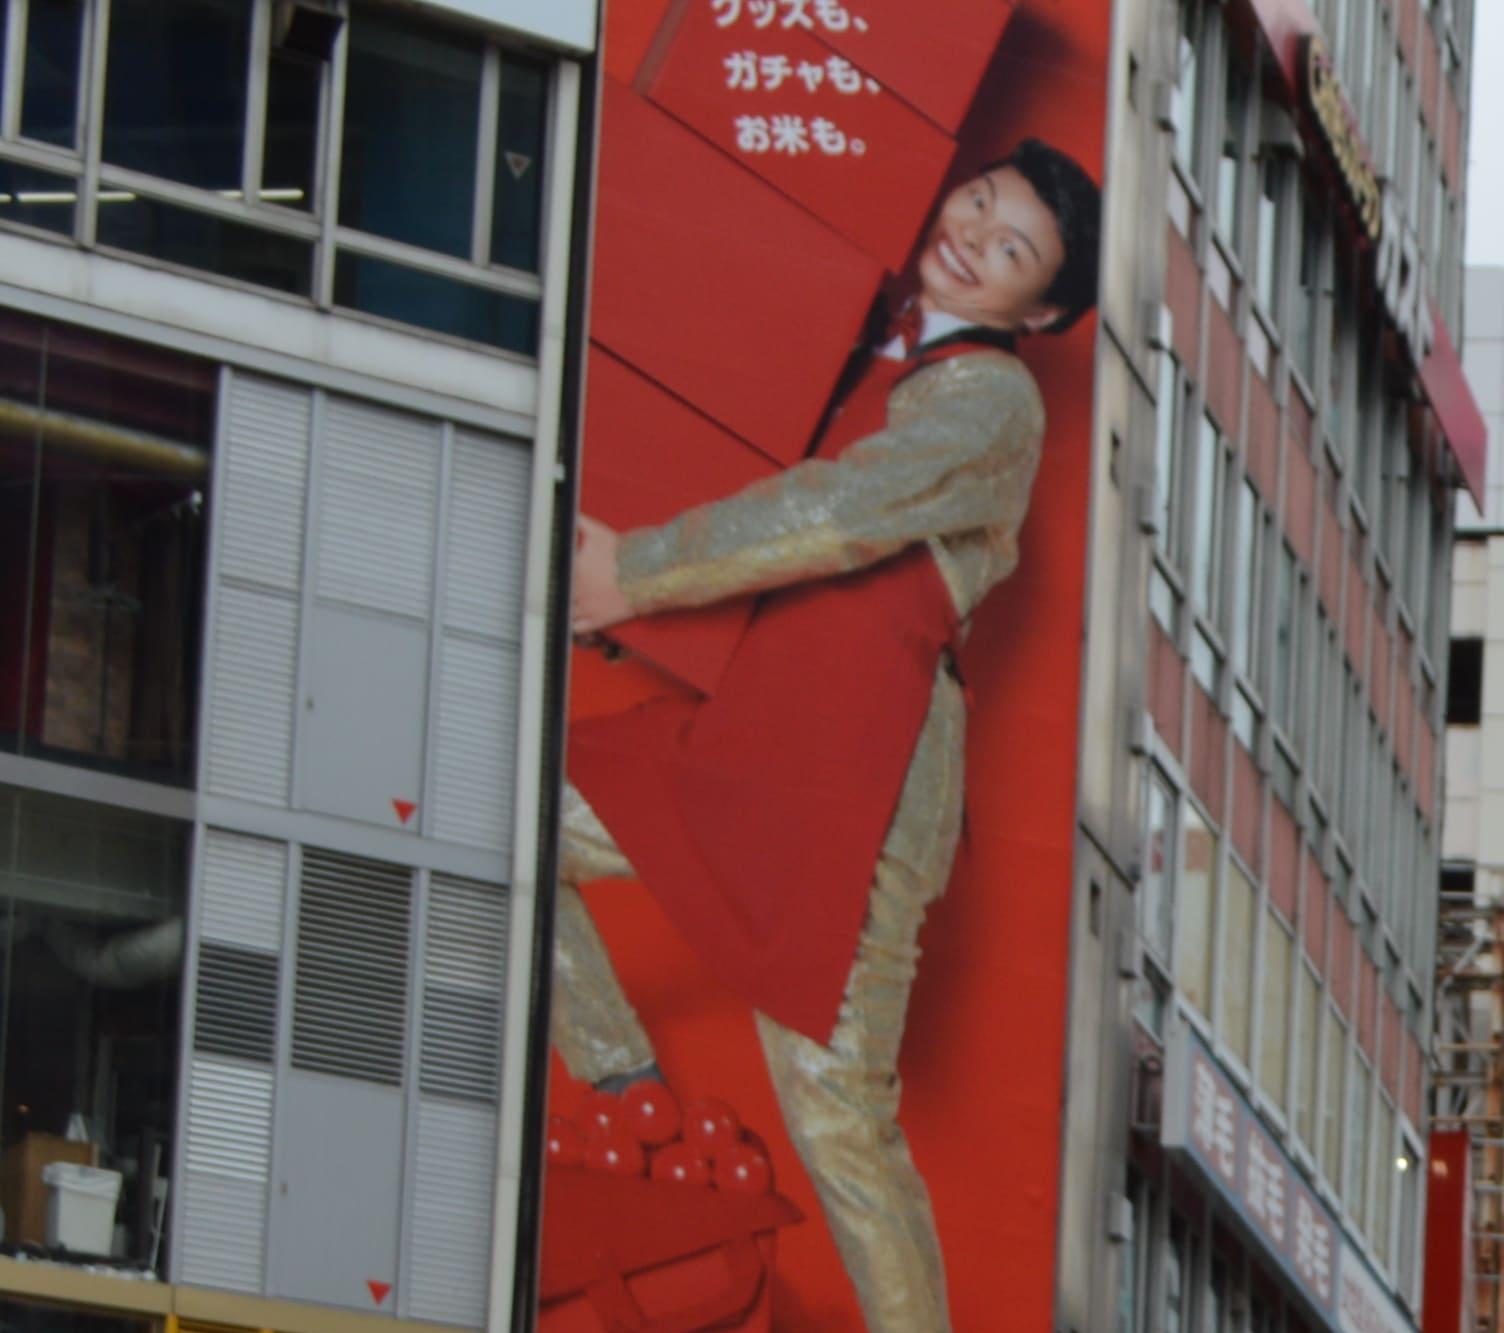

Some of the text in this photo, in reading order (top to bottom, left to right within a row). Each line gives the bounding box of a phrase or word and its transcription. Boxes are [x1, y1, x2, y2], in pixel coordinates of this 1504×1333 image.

[723, 51, 881, 93] ガチャも、
[734, 115, 866, 156] お米も。
